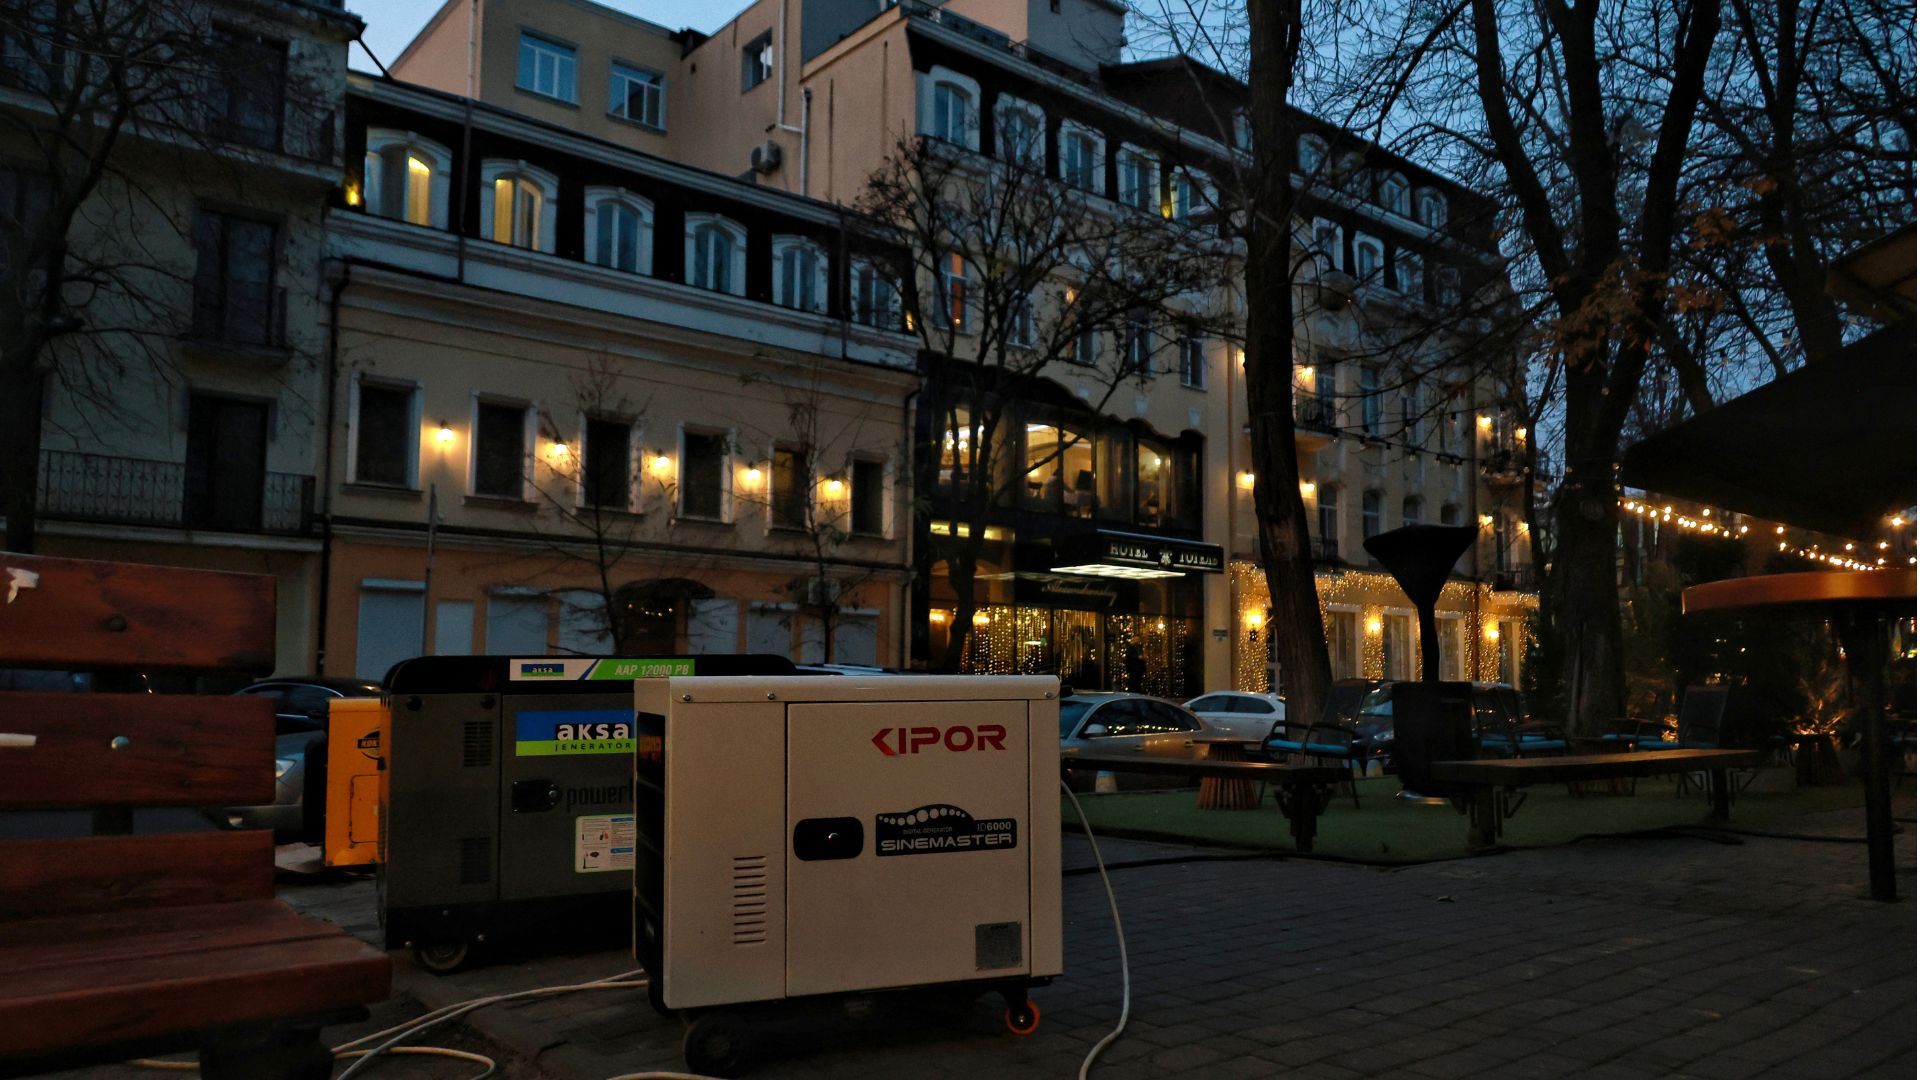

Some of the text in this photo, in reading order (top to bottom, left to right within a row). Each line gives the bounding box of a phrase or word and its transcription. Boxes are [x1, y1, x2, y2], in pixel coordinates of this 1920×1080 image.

[1109, 542, 1149, 559] HOTEL
[615, 664, 638, 676] AAP
[641, 664, 672, 676] 12000
[557, 723, 630, 741] aksa
[872, 724, 1007, 756] KIPOR
[555, 742, 631, 752] JENERATOR
[880, 832, 1013, 851] SINEMASTER
